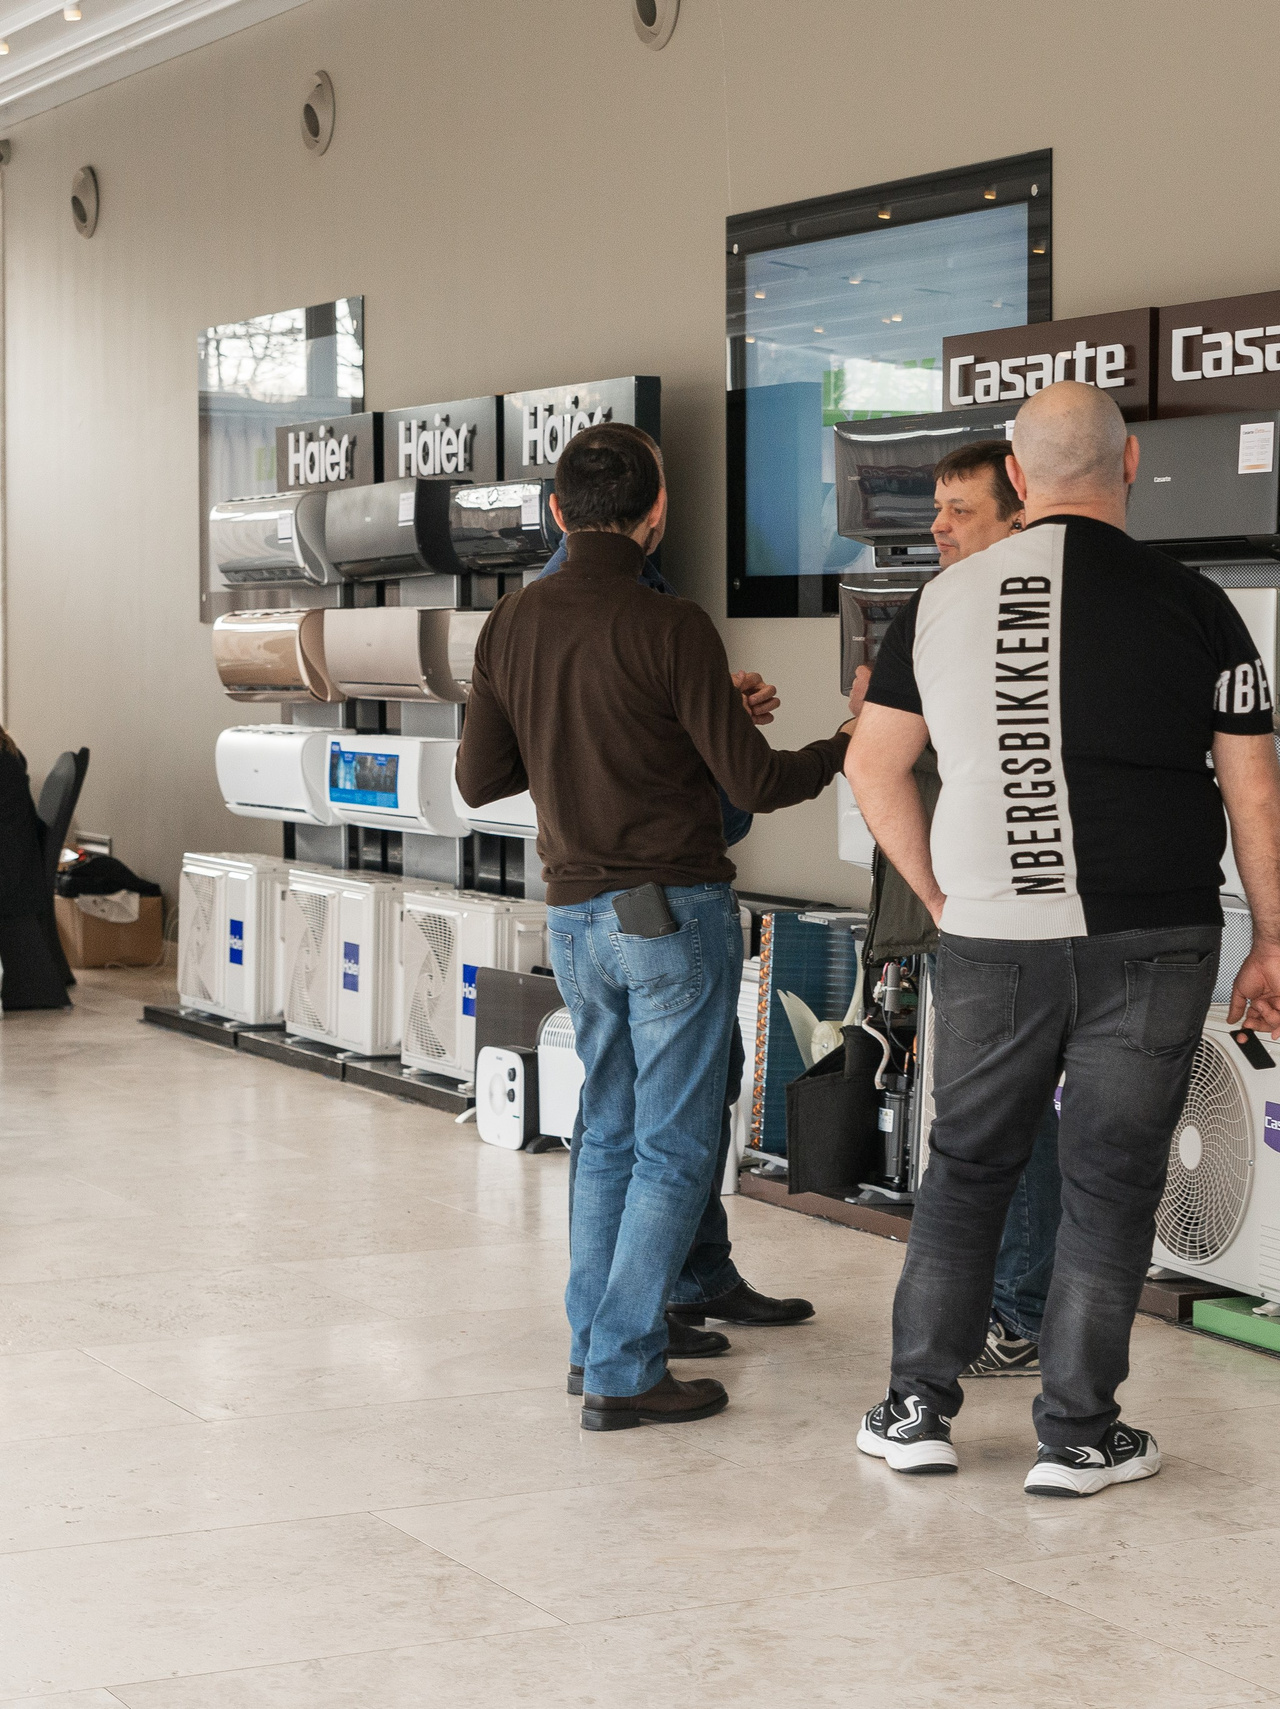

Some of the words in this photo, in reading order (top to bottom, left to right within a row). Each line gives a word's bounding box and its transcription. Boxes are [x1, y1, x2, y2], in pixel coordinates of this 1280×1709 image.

[949, 340, 1126, 406] Casarte
[288, 424, 349, 486] Haier
[398, 413, 468, 478] Haier
[522, 395, 603, 467] Hai
[462, 982, 477, 1000] Hai
